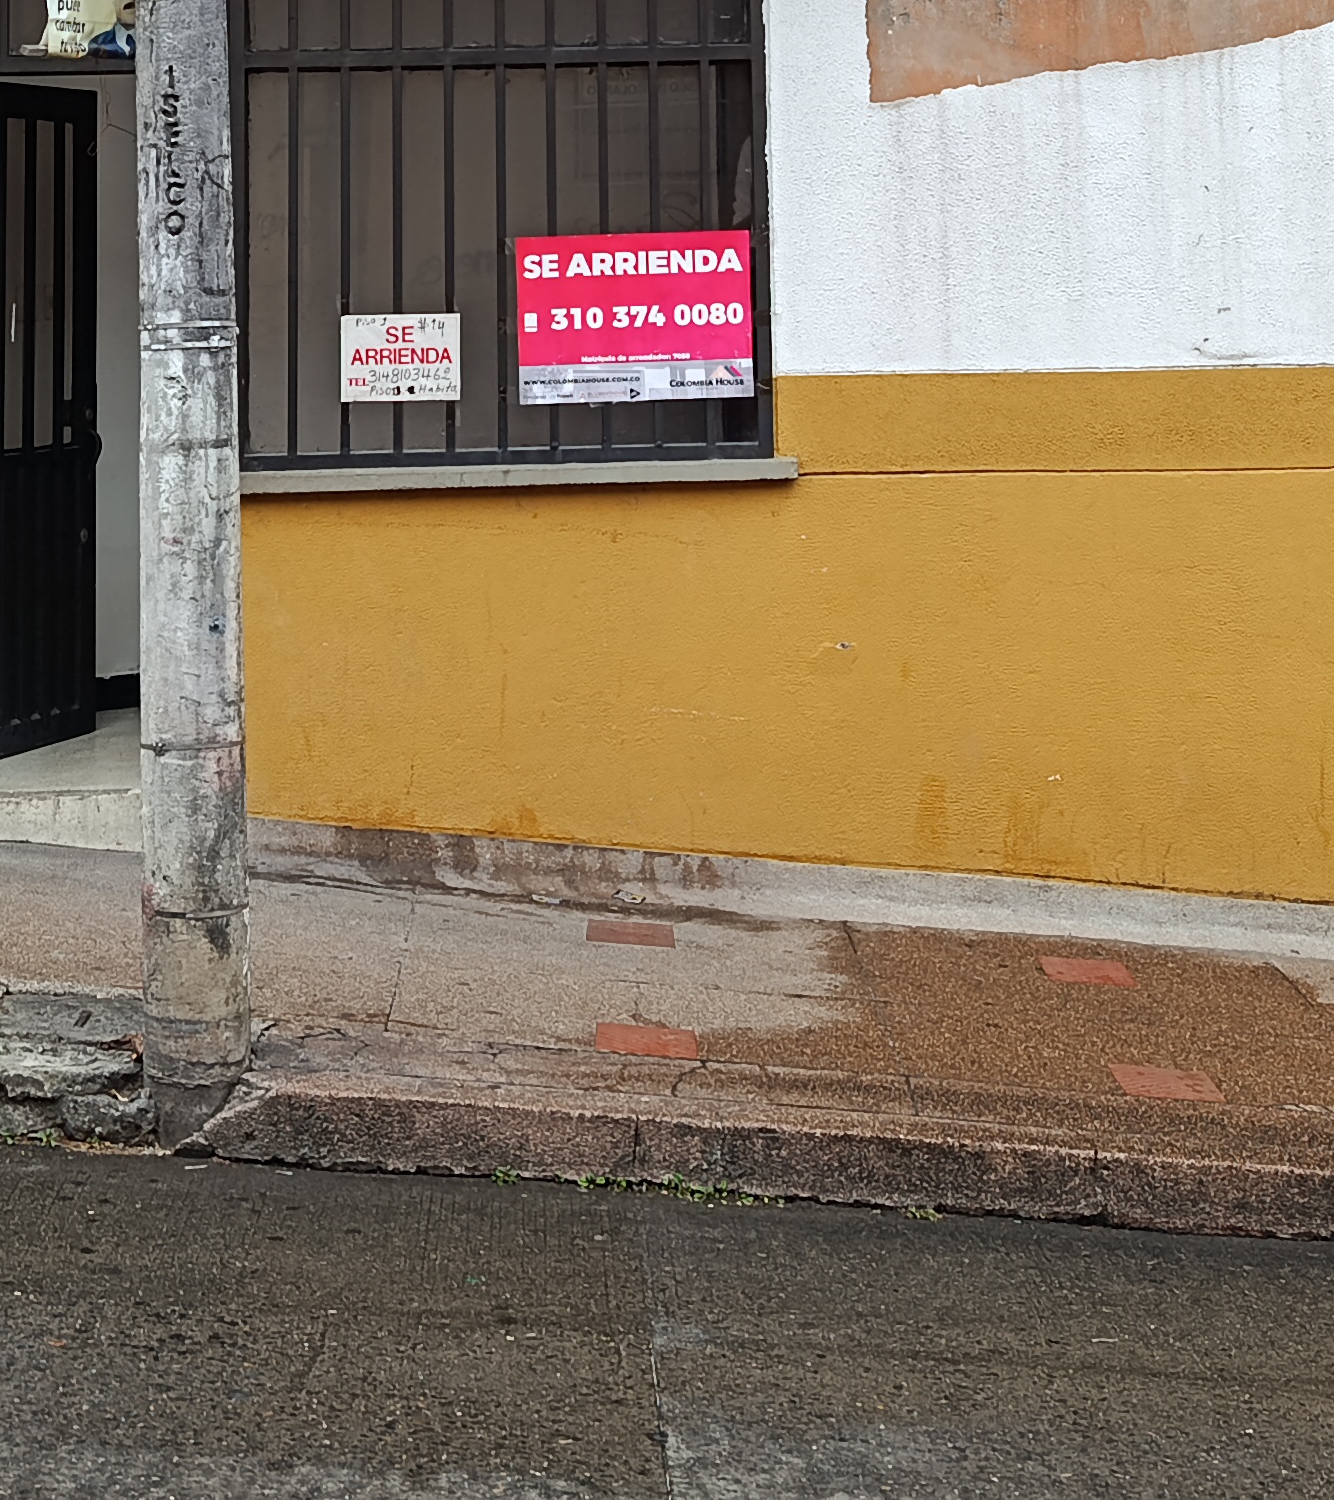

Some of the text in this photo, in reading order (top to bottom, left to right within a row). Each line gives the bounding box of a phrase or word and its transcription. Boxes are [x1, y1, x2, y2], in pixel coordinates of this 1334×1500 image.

[523, 248, 744, 279] SE ARRIENDA
[550, 302, 744, 330] 310 374 0080
[386, 326, 414, 344] SE
[351, 348, 452, 365] ARRIENDA
